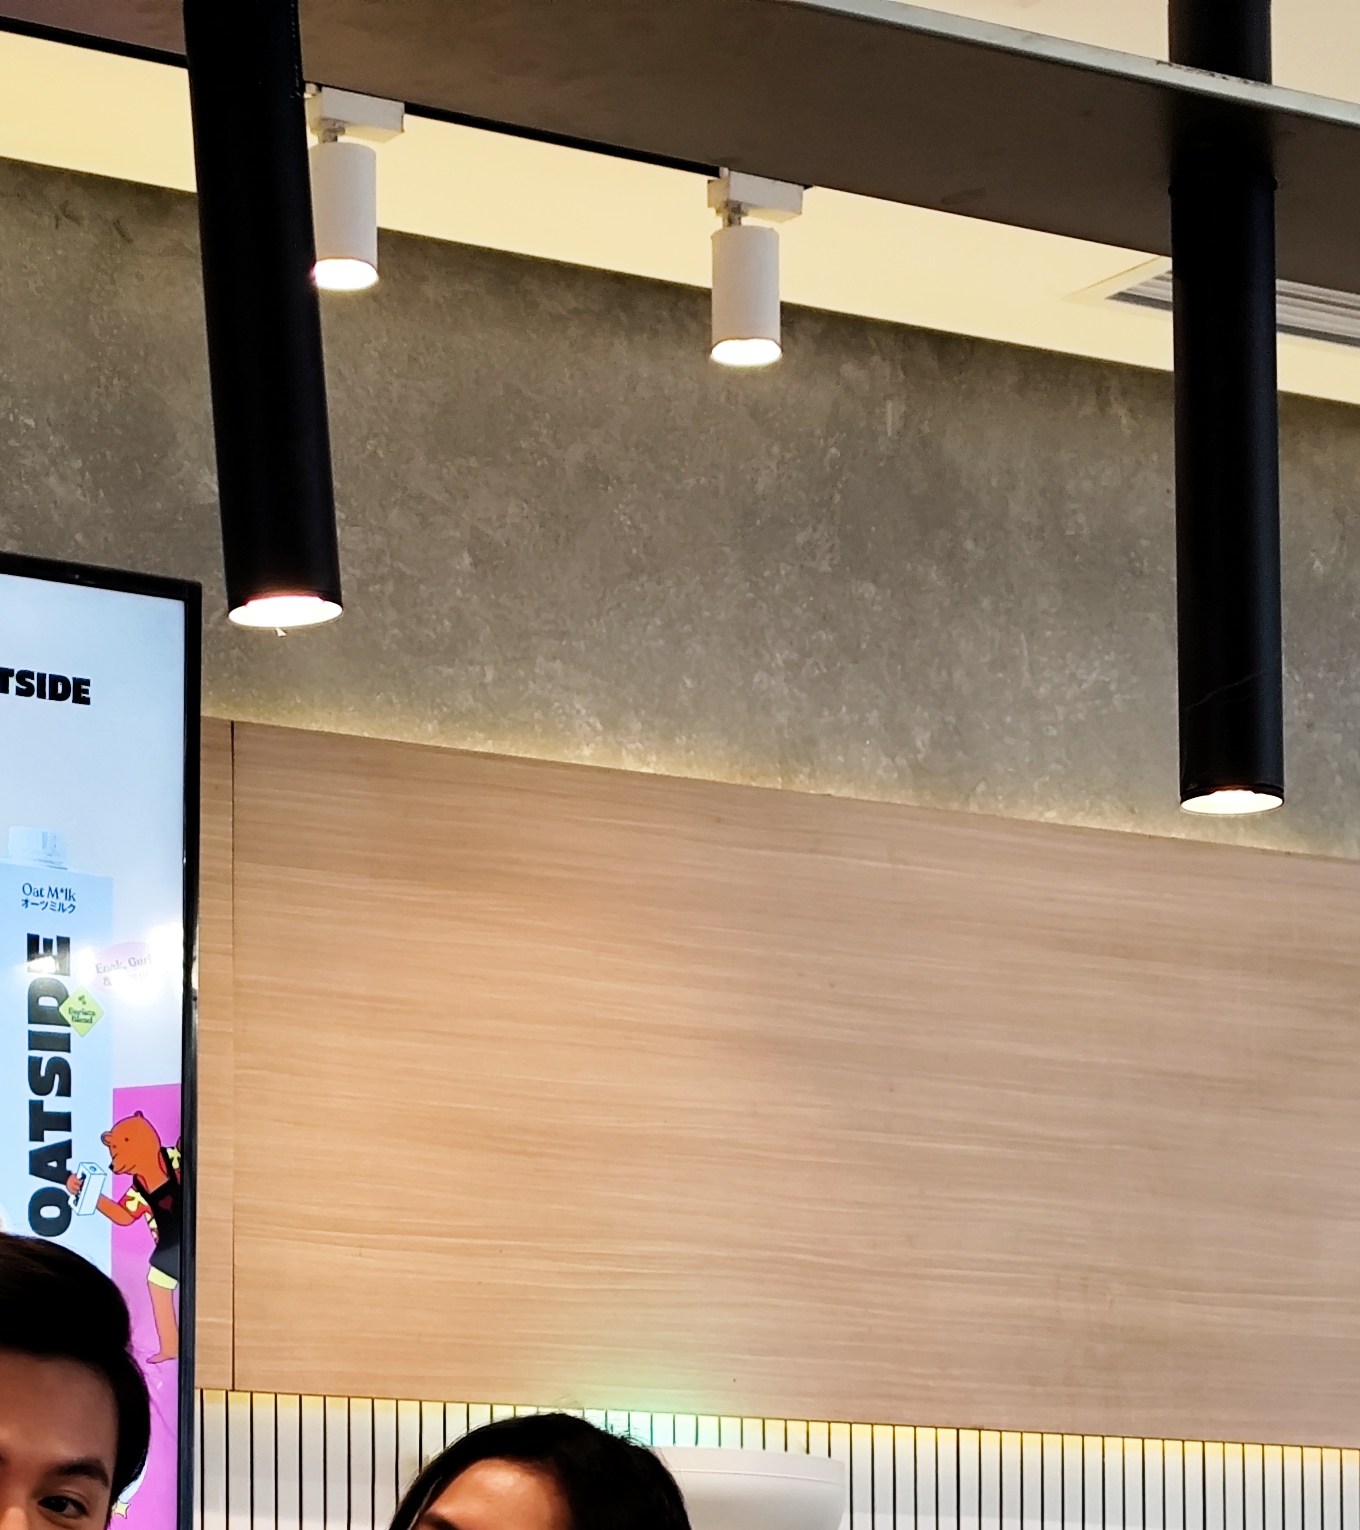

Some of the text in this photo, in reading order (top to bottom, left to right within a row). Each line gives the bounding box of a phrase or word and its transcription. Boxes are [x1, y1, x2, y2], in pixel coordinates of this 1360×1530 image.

[21, 882, 44, 898] Oat
[21, 898, 77, 914] オーツミルク
[26, 932, 72, 1238] OATSIDE
